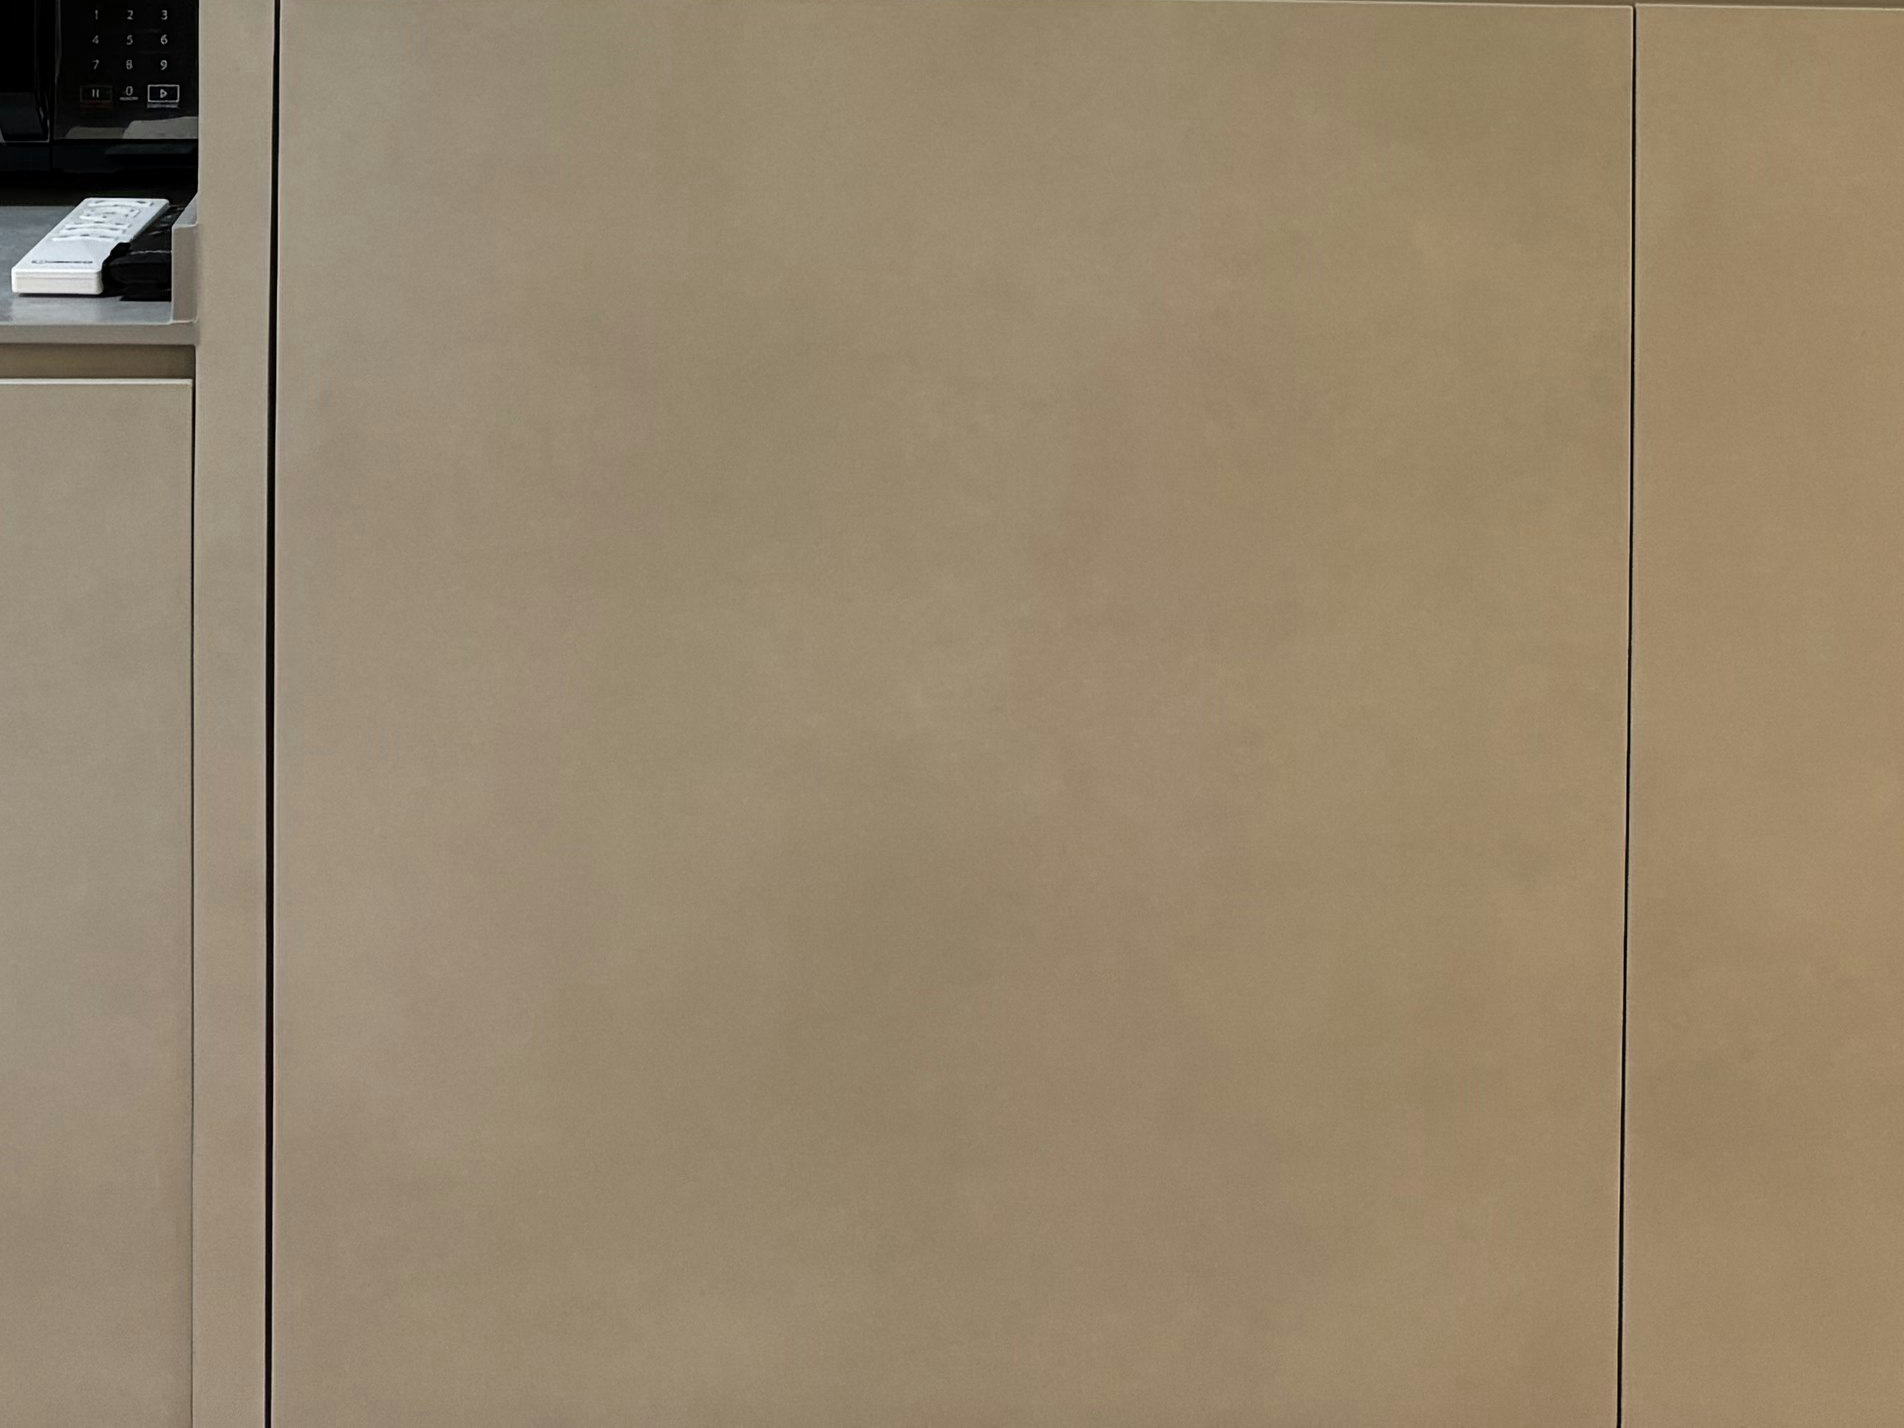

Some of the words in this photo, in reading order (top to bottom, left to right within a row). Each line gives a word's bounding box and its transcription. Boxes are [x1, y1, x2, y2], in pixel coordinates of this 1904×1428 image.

[94, 9, 99, 20] 1
[126, 9, 134, 20] 2
[161, 9, 168, 20] 3
[92, 34, 99, 44] 4
[126, 34, 133, 45] 5
[160, 34, 168, 45] 6
[92, 59, 99, 70] 7
[126, 59, 133, 70] 8
[160, 59, 168, 70] 9
[125, 85, 133, 96] 0
